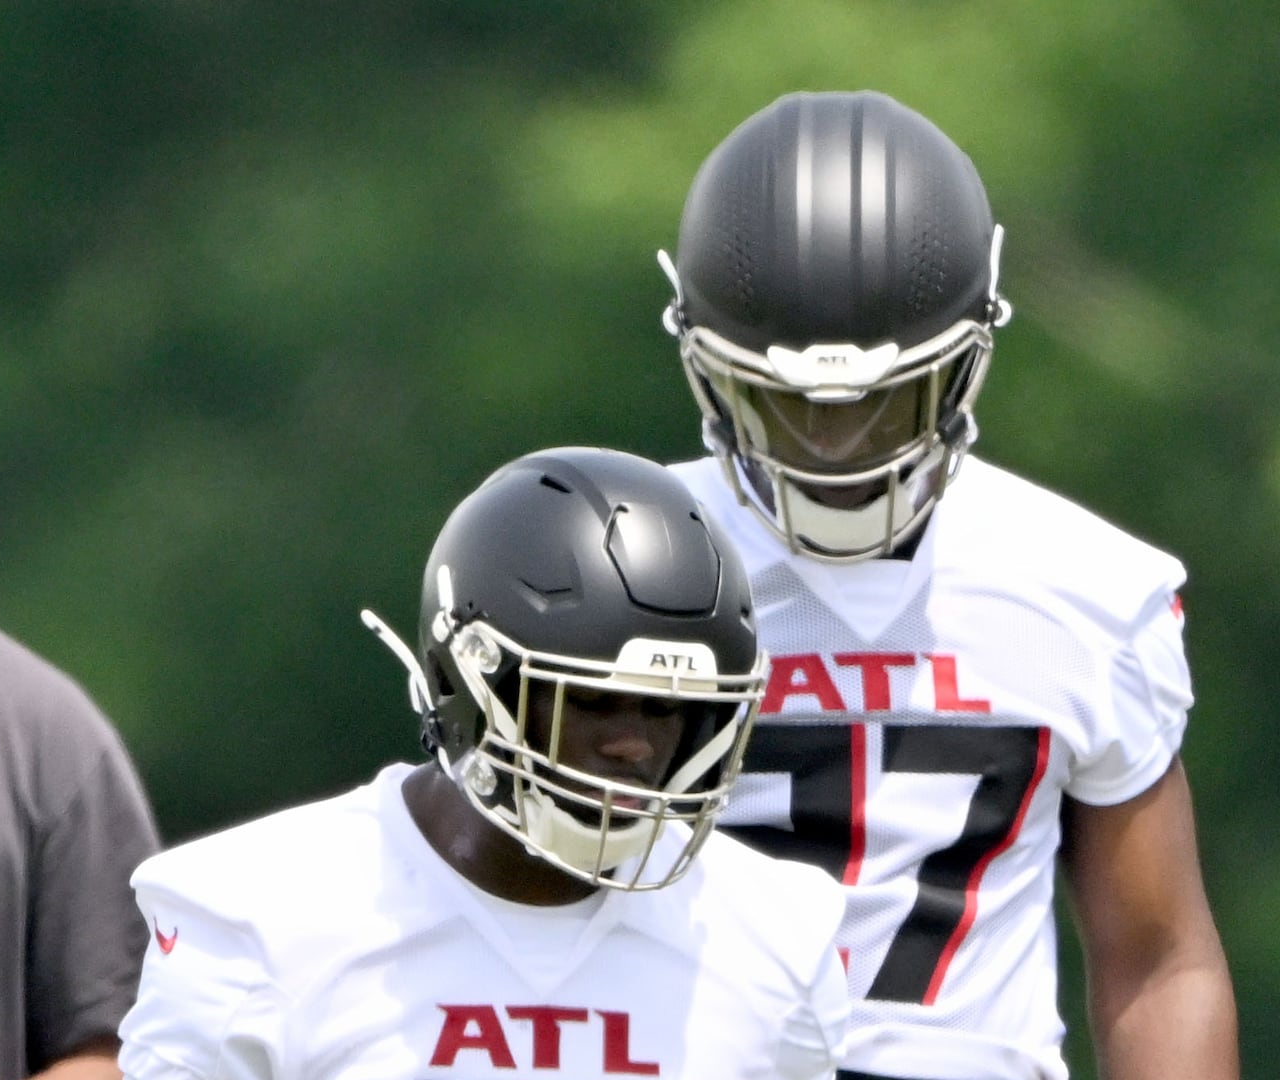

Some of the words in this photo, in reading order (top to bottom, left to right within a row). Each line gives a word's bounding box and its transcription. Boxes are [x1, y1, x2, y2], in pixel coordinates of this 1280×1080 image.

[650, 653, 698, 671] ATL
[758, 652, 991, 713] ATL
[429, 1003, 660, 1077] ATL
